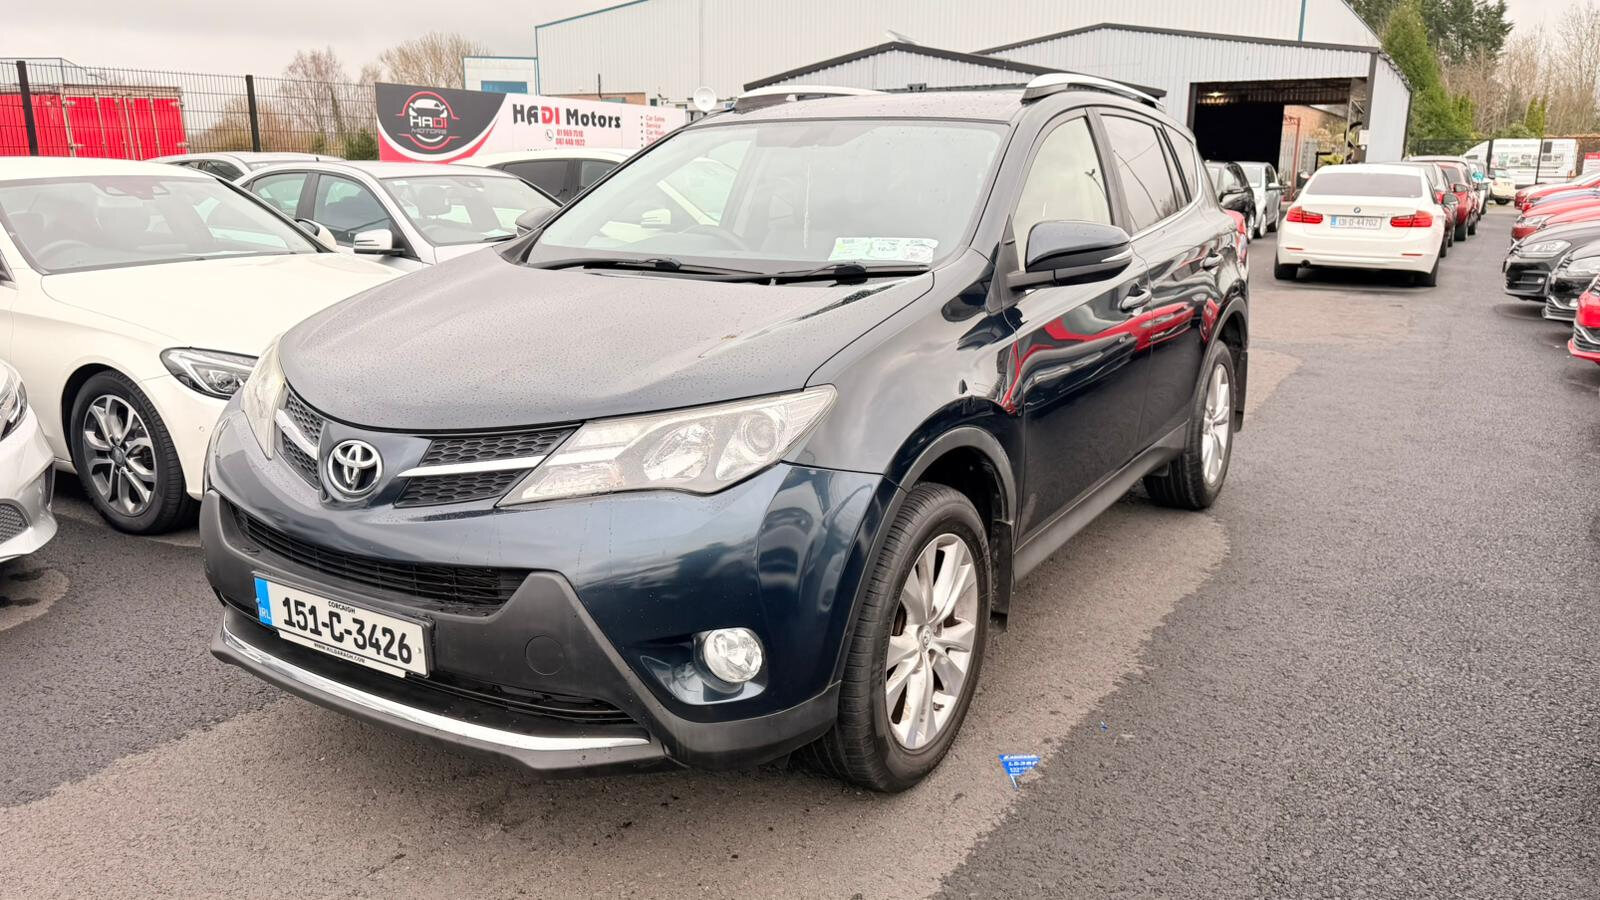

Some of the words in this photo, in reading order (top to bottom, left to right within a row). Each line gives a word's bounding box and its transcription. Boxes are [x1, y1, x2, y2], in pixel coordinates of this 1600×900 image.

[409, 116, 448, 128] HADI
[512, 103, 560, 126] HADI
[566, 108, 621, 128] Motors
[327, 600, 356, 614] CORCAIGH
[282, 597, 412, 665] 151-C-3426
